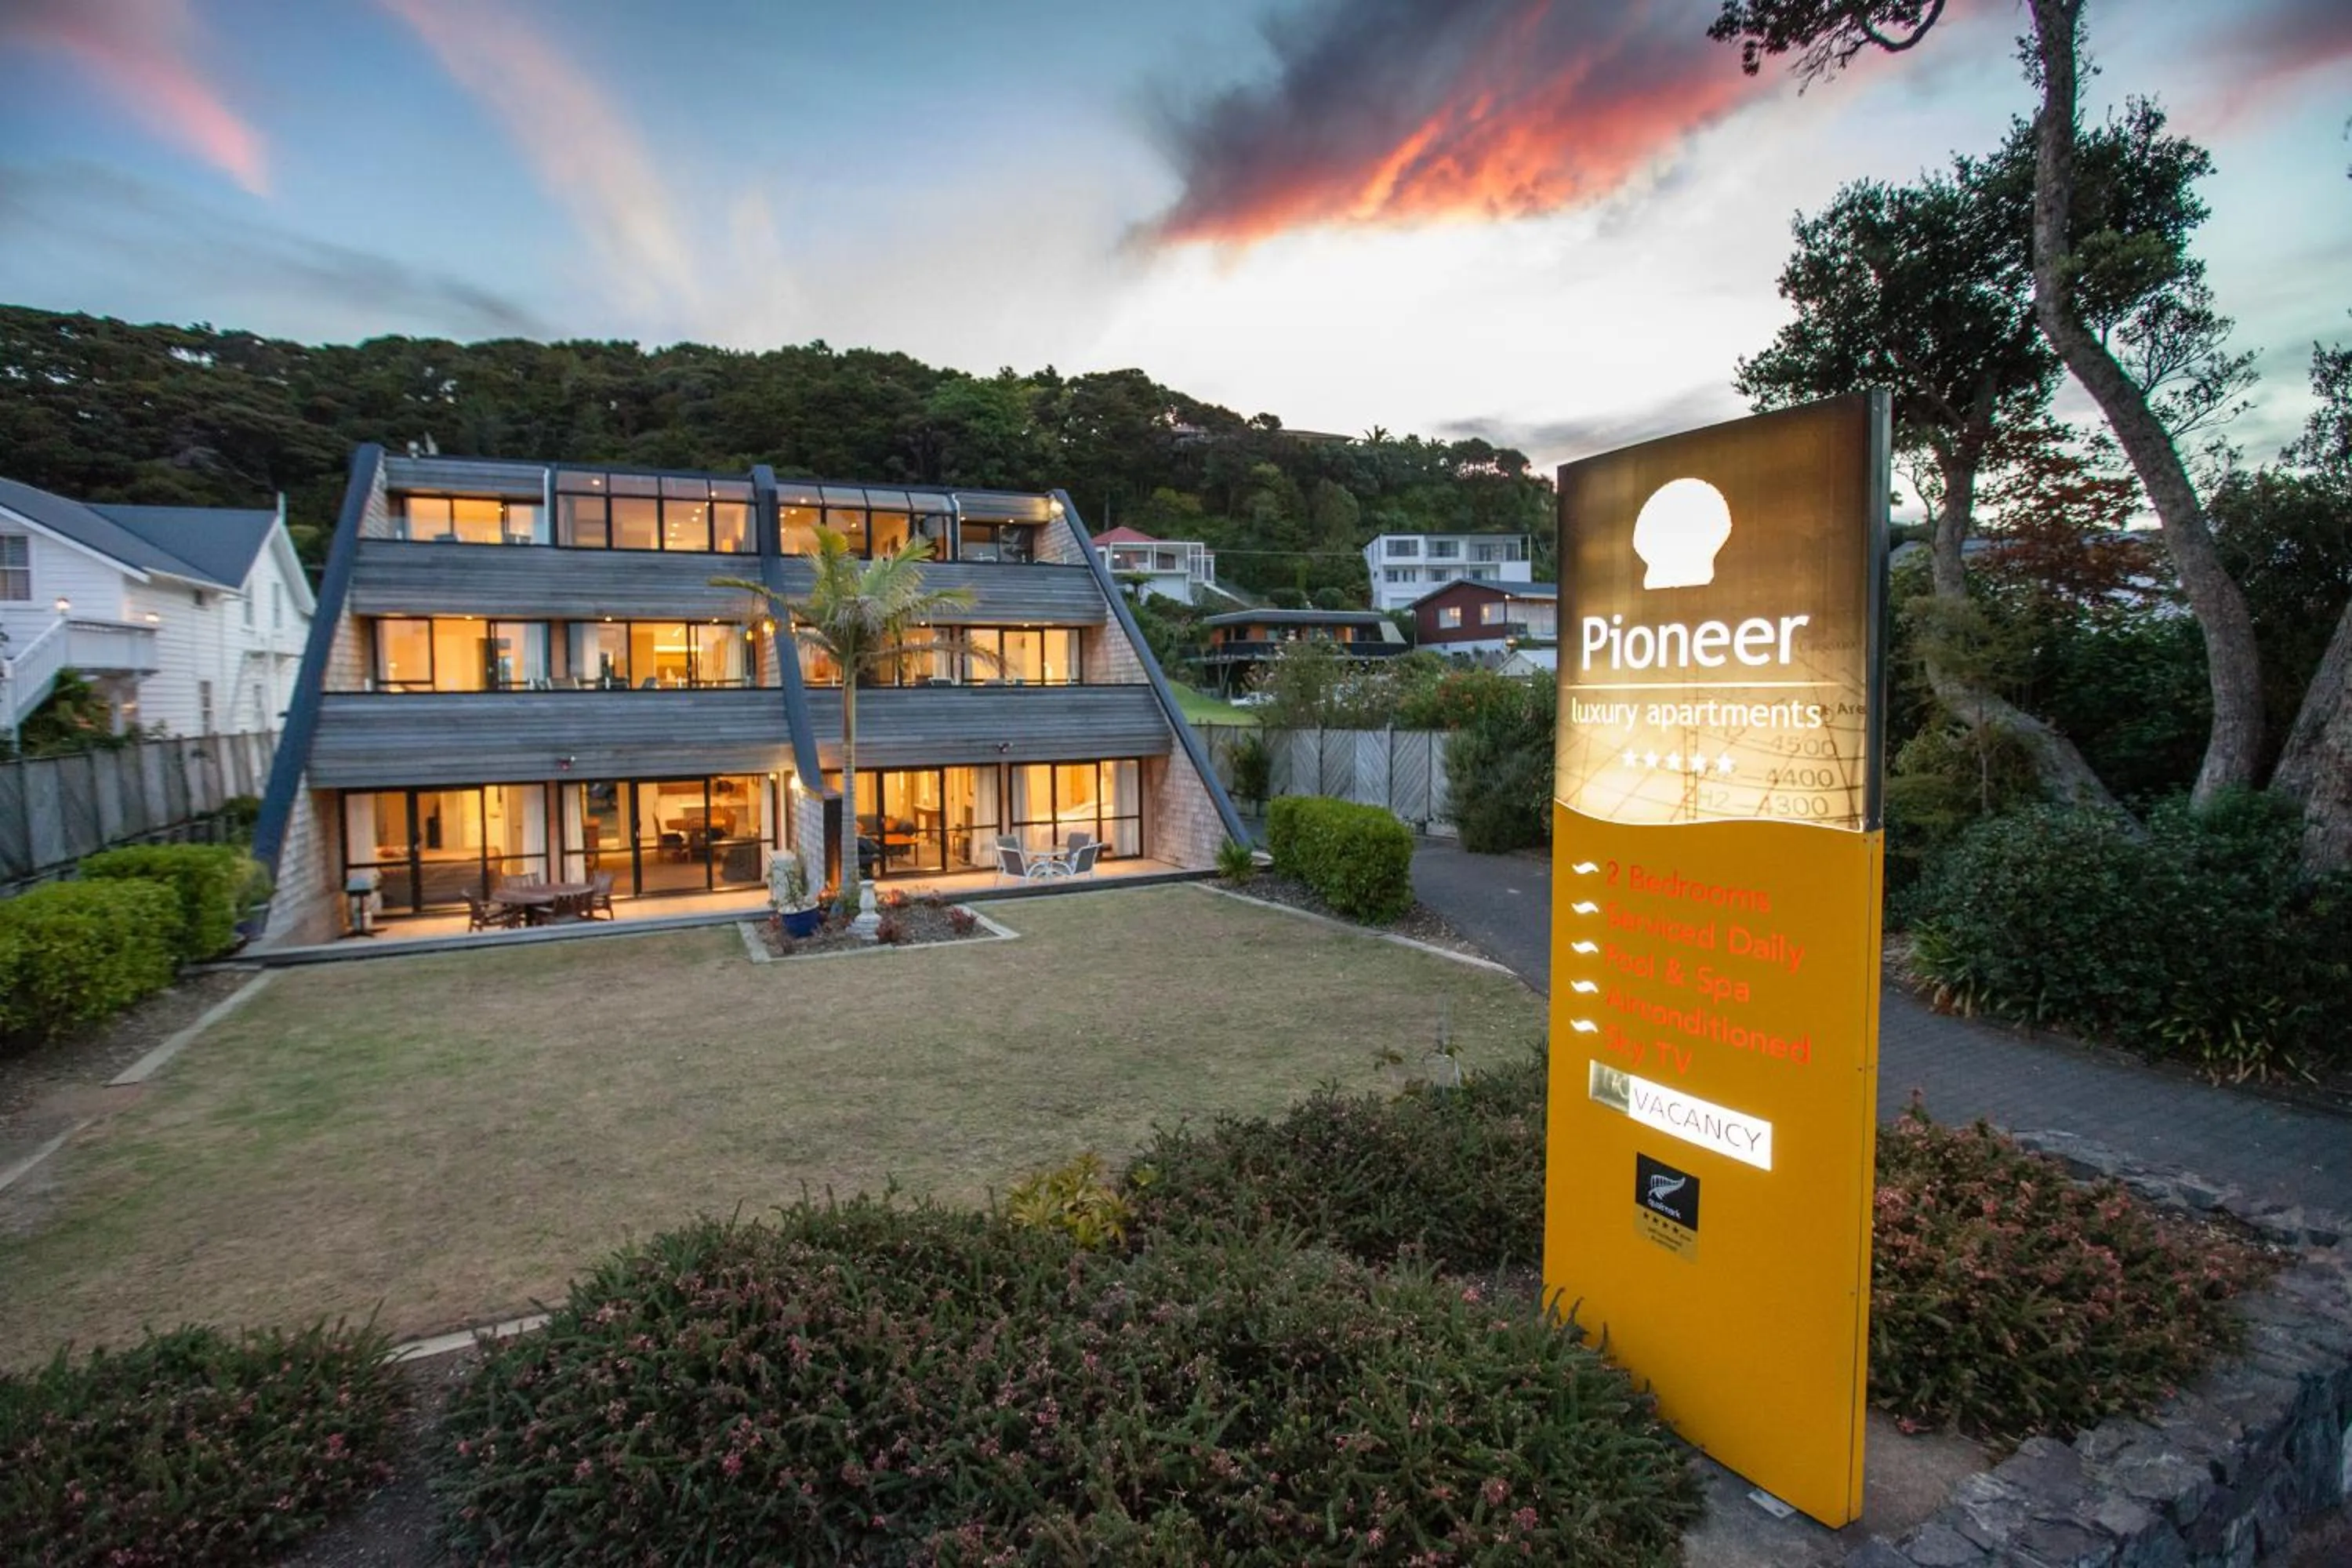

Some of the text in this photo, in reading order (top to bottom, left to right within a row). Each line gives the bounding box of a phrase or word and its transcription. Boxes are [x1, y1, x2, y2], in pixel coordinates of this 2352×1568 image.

[1582, 614, 1810, 671] Pioneer
[1571, 697, 1638, 731] luxury
[1646, 700, 1823, 732] apartments
[1770, 736, 1836, 756] 4500
[1766, 768, 1835, 789] 4400
[1606, 859, 1772, 914] 2 Bedrooms
[1605, 902, 1804, 975] Serviced Daily
[1605, 943, 1751, 1005] Pool & Spa
[1604, 1024, 1693, 1075] Sky TV
[1606, 986, 1811, 1065] Airconditioned
[1633, 1087, 1762, 1152] VACANCY
